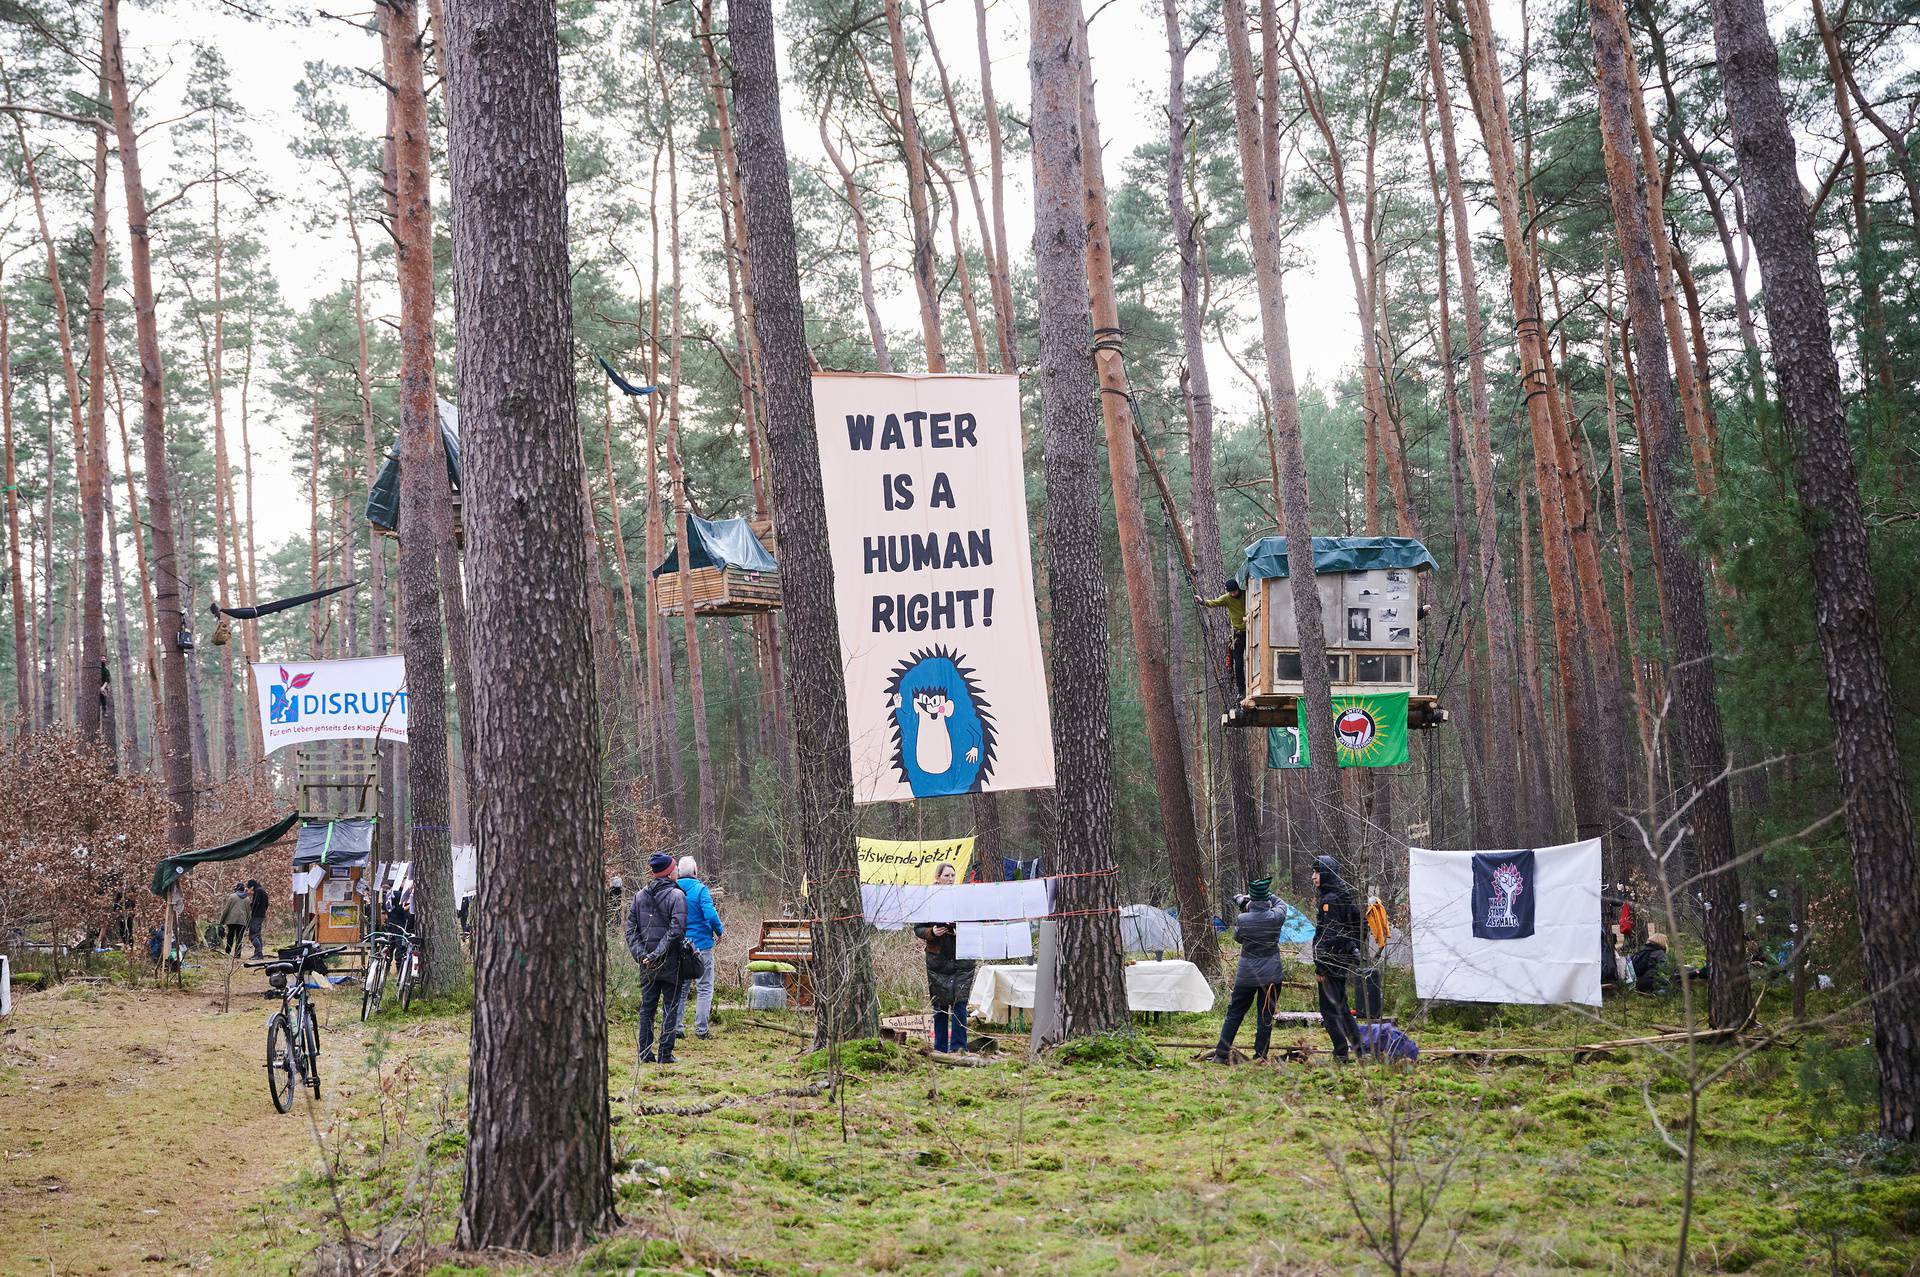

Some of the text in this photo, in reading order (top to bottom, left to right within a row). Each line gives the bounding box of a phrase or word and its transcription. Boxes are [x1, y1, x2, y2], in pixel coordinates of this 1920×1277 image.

[846, 411, 978, 450] WATER
[883, 472, 956, 511] IS A
[863, 529, 993, 574] HUMAN
[872, 588, 994, 632] RIGHT!
[304, 692, 408, 715] DISRUPT
[314, 725, 341, 733] jenseits
